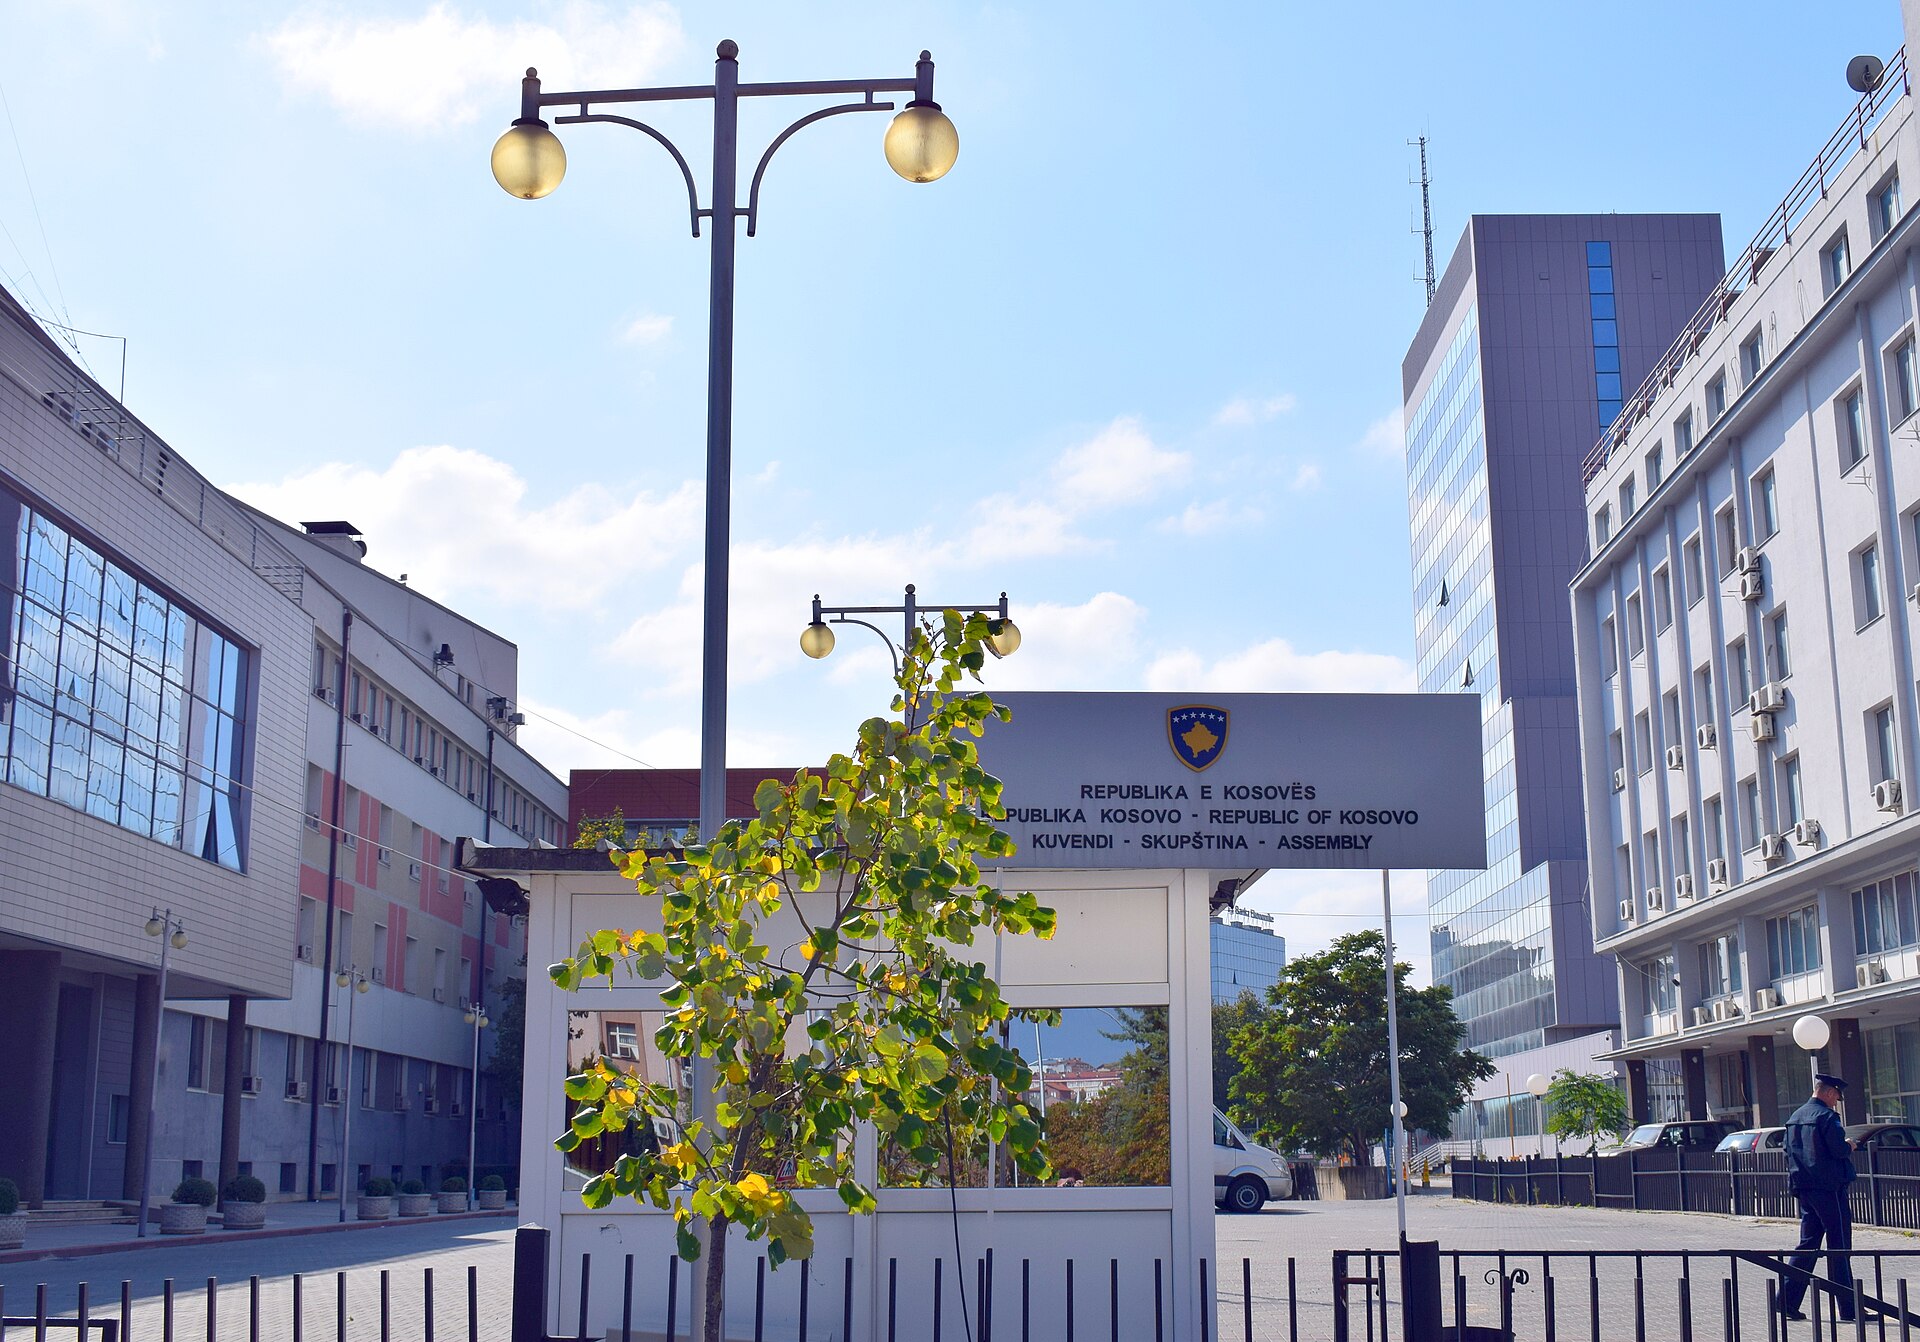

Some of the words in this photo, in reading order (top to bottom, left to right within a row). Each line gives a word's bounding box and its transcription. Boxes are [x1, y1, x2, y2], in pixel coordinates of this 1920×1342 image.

[1080, 784, 1189, 800] REPUBLIKA
[1200, 785, 1213, 800] E
[1223, 781, 1316, 801] KOSOVËS
[981, 807, 1087, 824] PUBLIKA
[1100, 808, 1182, 824] KOSOVO
[1209, 809, 1300, 825] REPUBLIC
[1307, 809, 1332, 825] OF
[1339, 809, 1419, 825] KOSOVO
[1032, 833, 1114, 849] KUVENDI
[1140, 830, 1249, 850] SKUPŠTINA
[1276, 834, 1374, 851] ASSEMBLY
